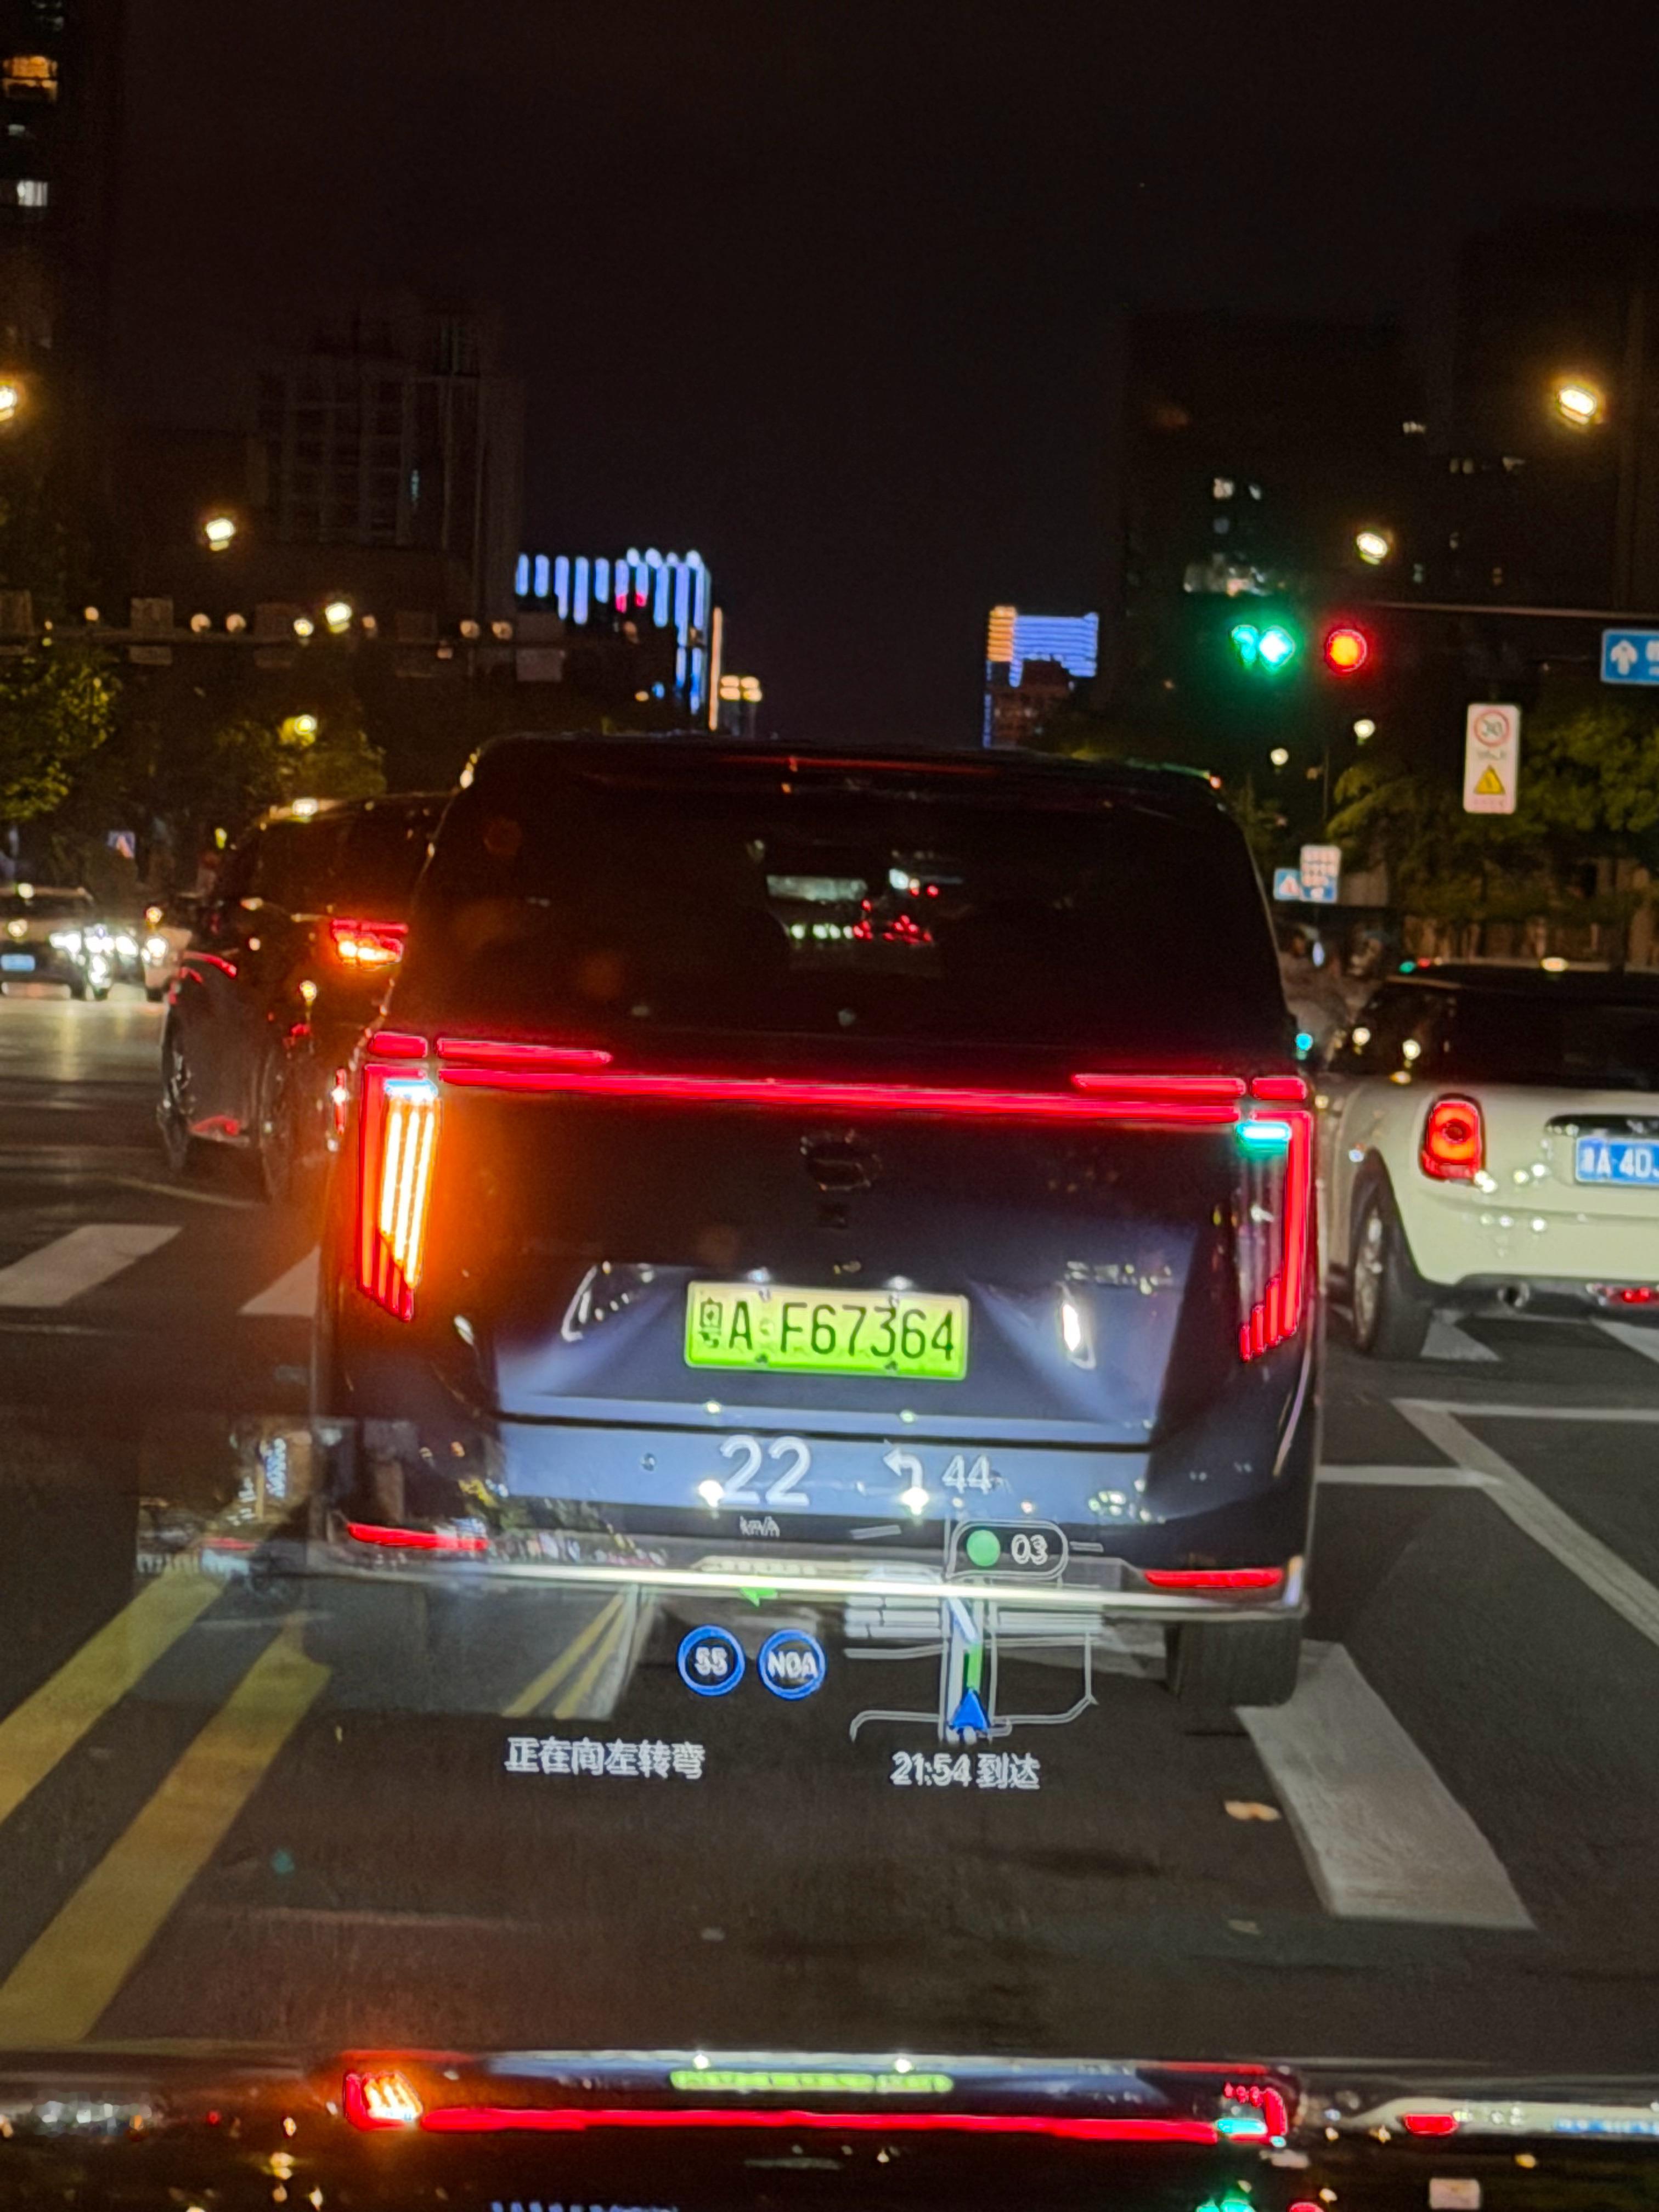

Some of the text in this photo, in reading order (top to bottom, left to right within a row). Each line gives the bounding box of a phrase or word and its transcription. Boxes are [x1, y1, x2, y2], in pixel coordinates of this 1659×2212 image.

[780, 1302, 953, 1361] F67364
[720, 1434, 811, 1506] 22
[1011, 1533, 1048, 1566] 03
[768, 1649, 819, 1679] NOA
[504, 1735, 706, 1780] 正在向左转弯
[889, 1751, 1041, 1790] 21:54 到达
